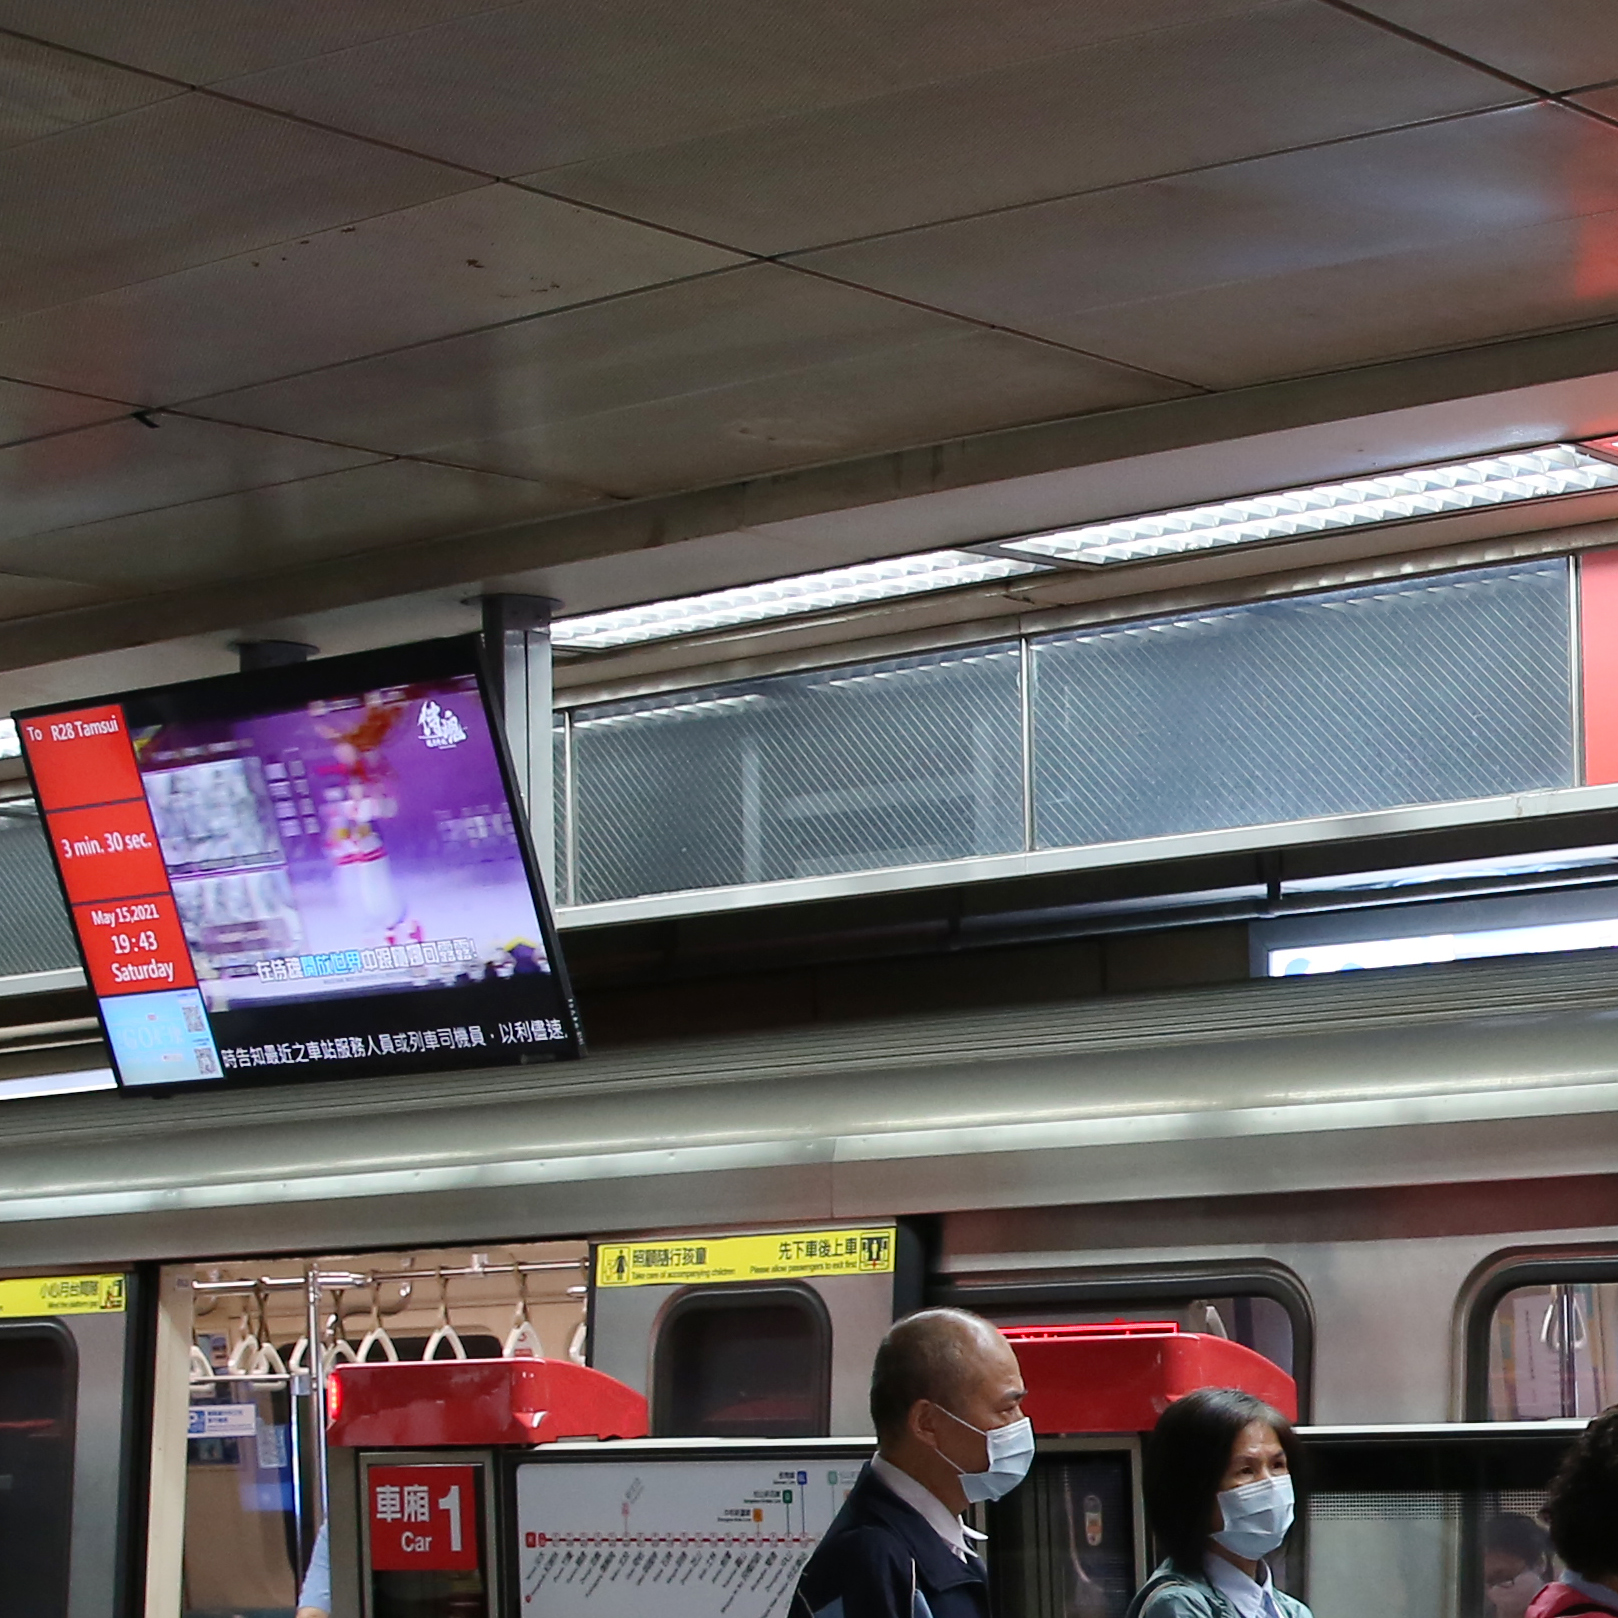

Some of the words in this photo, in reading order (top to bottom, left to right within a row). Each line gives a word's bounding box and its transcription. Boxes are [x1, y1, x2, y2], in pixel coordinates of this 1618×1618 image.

[27, 725, 43, 741] To
[50, 723, 75, 741] R28
[75, 714, 119, 738] Tamsui
[61, 838, 73, 858] 3
[74, 835, 104, 858] min.
[104, 832, 124, 851] 30
[125, 830, 152, 849] sec.
[91, 908, 117, 928] May
[111, 930, 158, 955] 19:43
[111, 959, 175, 983] Saturday
[778, 1237, 857, 1261] 先下車後上車
[376, 1484, 430, 1523] 車廂
[439, 1485, 462, 1552] 1
[401, 1531, 433, 1553] Car
